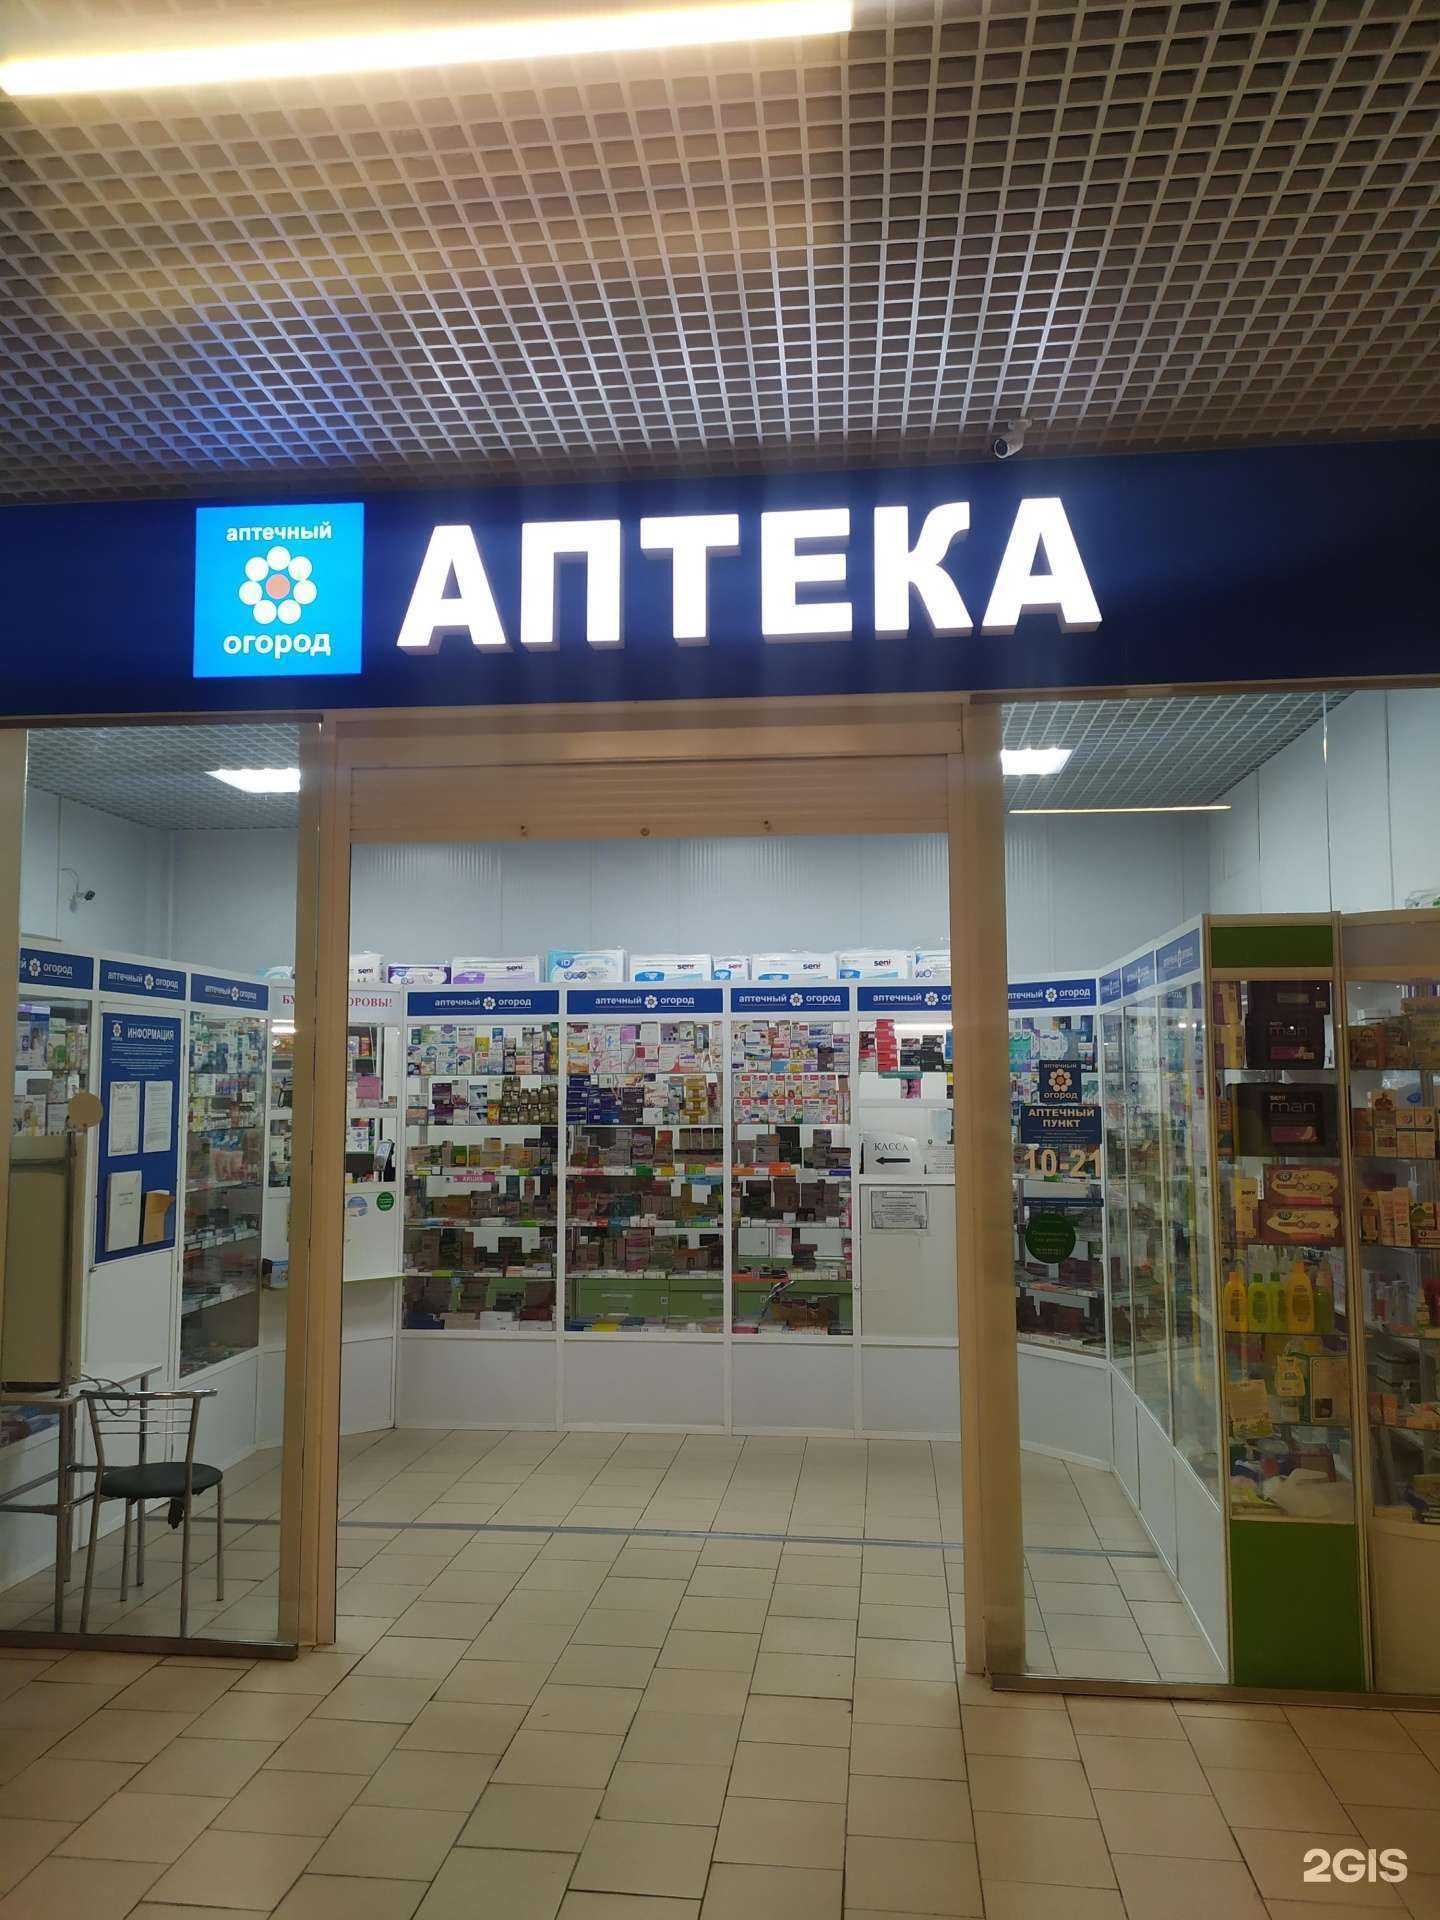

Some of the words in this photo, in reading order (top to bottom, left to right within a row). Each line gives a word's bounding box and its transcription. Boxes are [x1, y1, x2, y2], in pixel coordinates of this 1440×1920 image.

[226, 521, 332, 542] аптечный
[397, 497, 1103, 653] АПТЕКА
[223, 633, 332, 659] огород
[802, 962, 821, 970] seni
[873, 959, 891, 967] seni
[43, 963, 73, 976] огород
[107, 971, 143, 984] аптечный
[155, 977, 179, 989] огород
[739, 993, 787, 1004] аптечный
[805, 994, 841, 1004] огород
[873, 992, 922, 1003] аптечный
[1008, 989, 1043, 1000] птечный
[1059, 988, 1091, 998] огород
[434, 996, 481, 1008] аптечный
[498, 997, 532, 1008] огород
[595, 995, 642, 1006] аптечный
[660, 996, 695, 1006] огород
[127, 1026, 174, 1041] ИНФОРМАЦИЯ
[1043, 1092, 1078, 1100] огород
[1028, 1107, 1095, 1118] АПТЕЧНЫЙ
[1270, 1102, 1316, 1113] man
[1042, 1119, 1081, 1128] ПУНКТ
[873, 1142, 909, 1152] КАССА
[1024, 1147, 1101, 1178] 10-21
